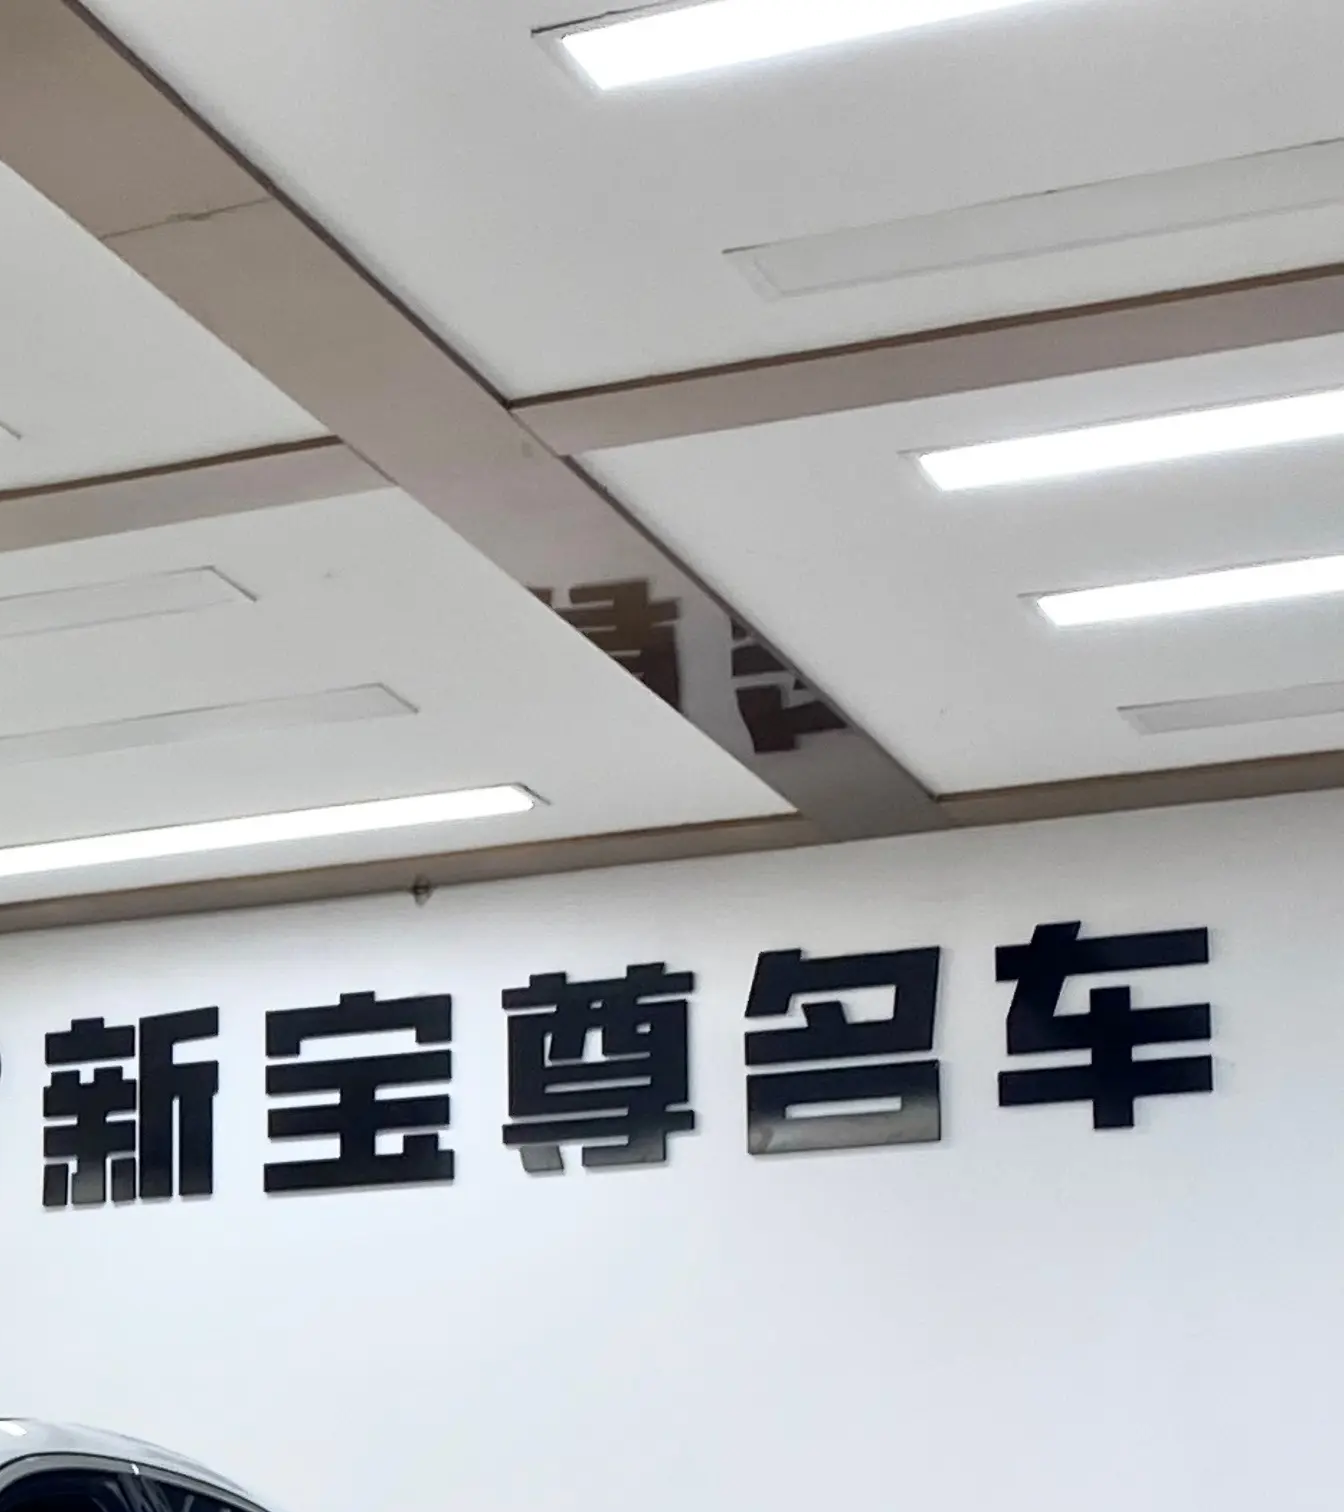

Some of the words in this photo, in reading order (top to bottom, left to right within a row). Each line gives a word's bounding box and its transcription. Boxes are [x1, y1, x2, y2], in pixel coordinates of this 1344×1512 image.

[42, 919, 1215, 1208] 新宝尊名车
